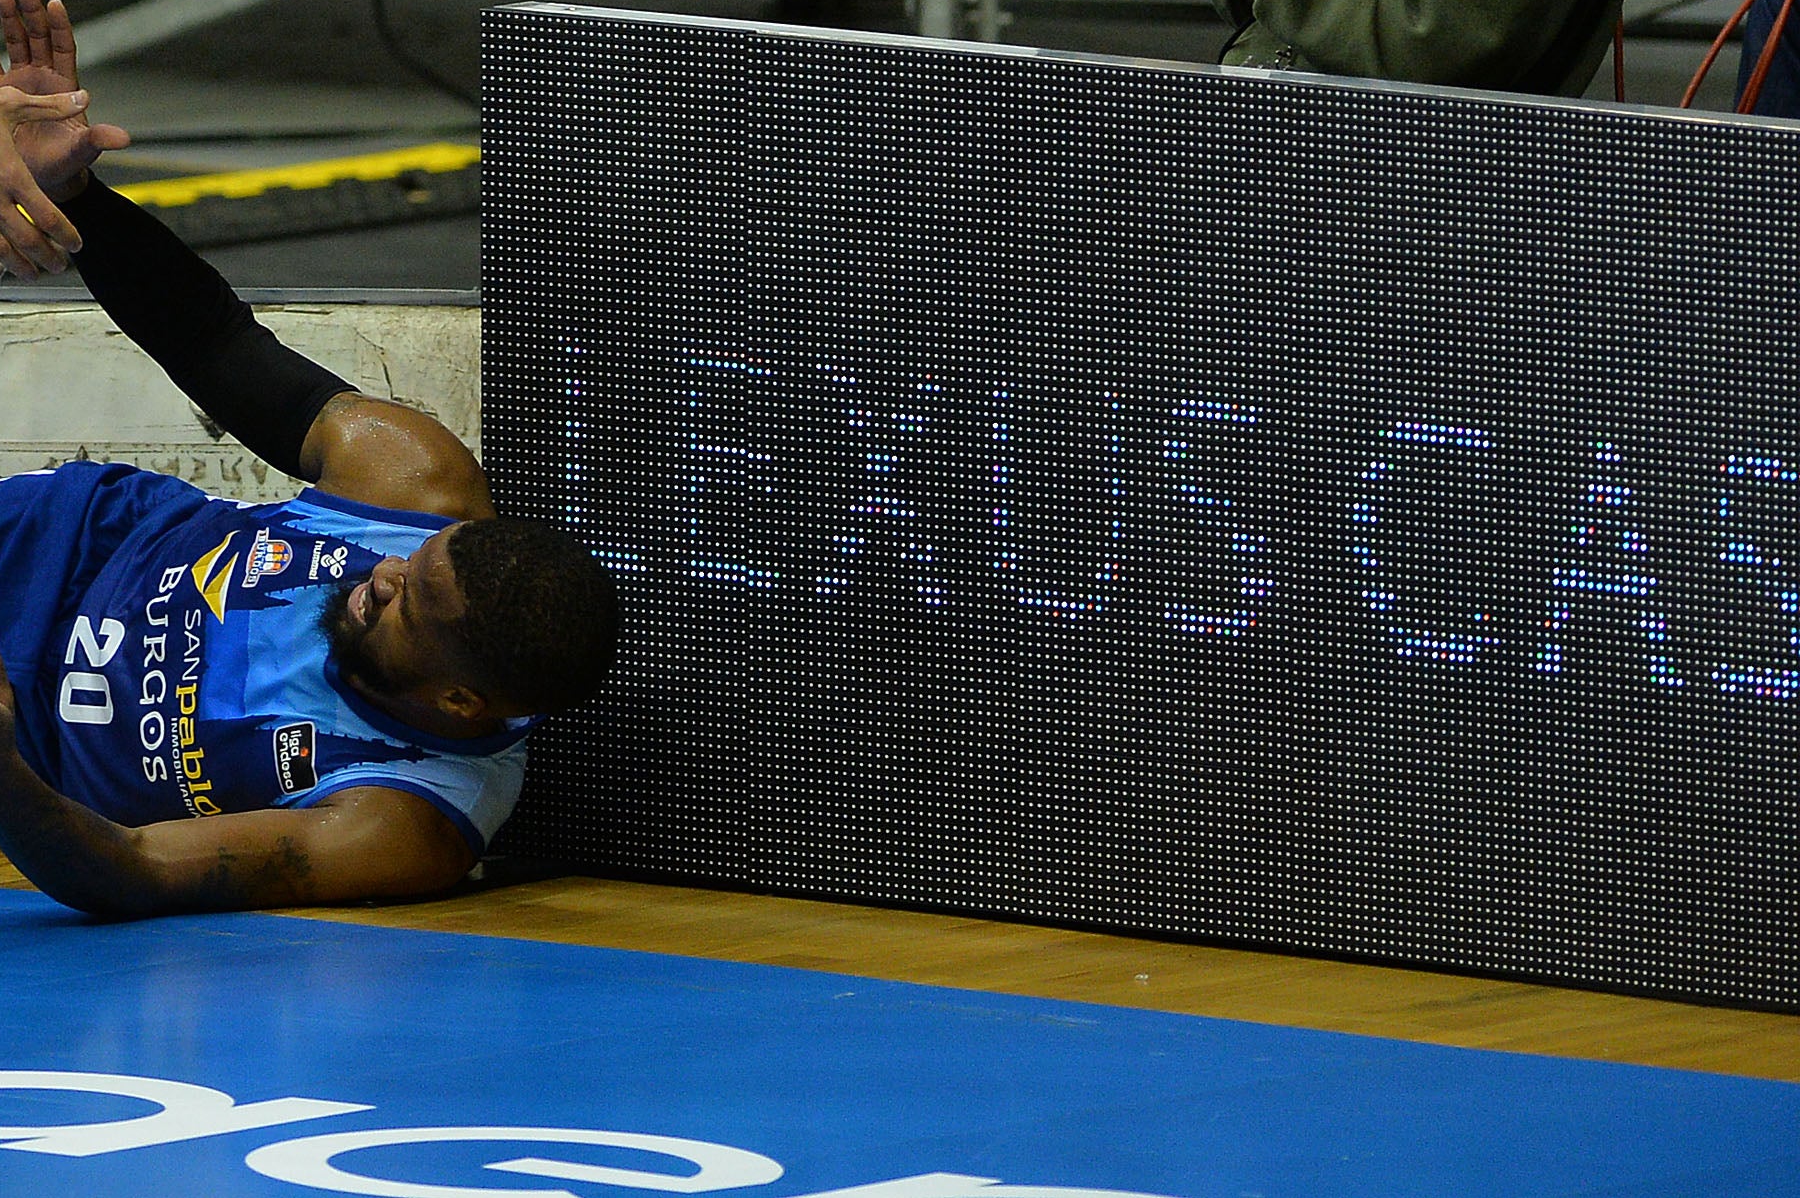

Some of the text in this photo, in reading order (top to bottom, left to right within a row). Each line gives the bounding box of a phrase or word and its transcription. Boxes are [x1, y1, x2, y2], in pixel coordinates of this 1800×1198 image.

[307, 540, 326, 581] hummel
[555, 337, 1272, 640] LEXUS
[59, 615, 126, 725] 20
[138, 563, 189, 783] BURGOS
